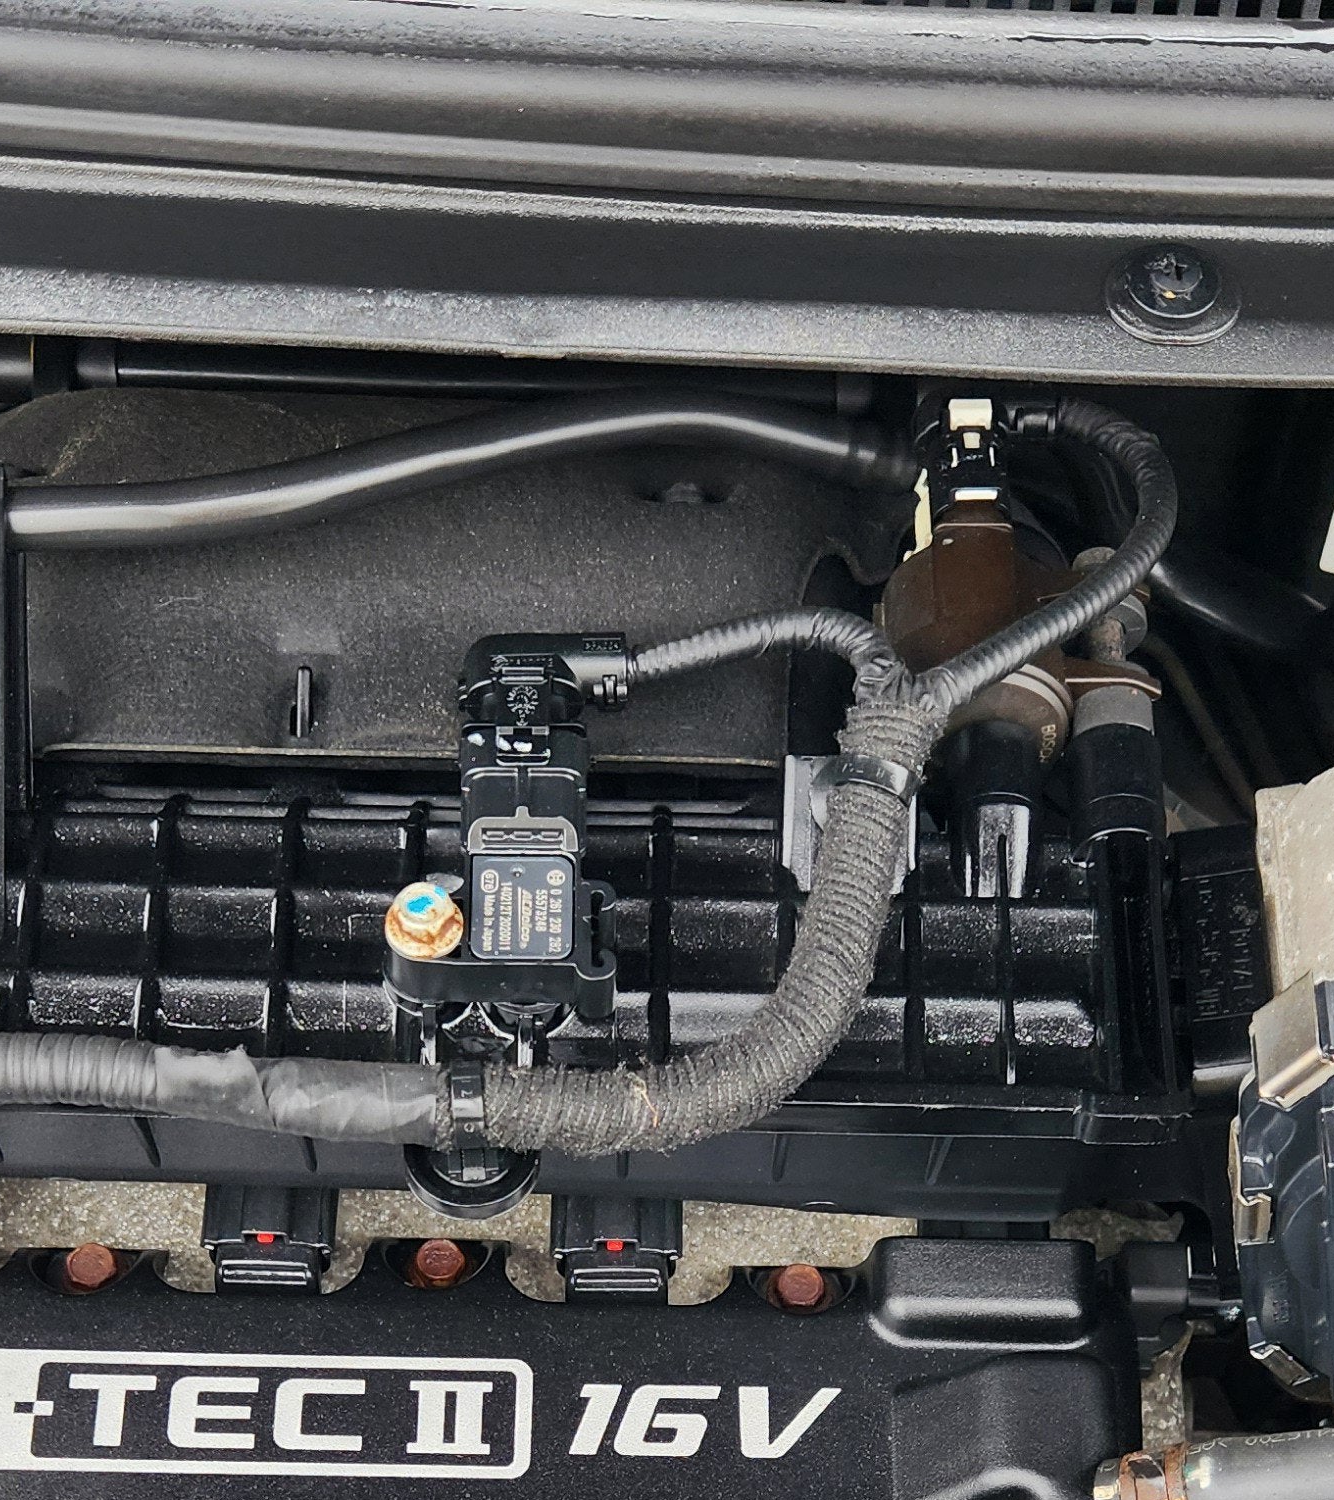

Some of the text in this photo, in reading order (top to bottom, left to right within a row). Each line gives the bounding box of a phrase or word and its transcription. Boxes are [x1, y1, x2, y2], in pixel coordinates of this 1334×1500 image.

[1037, 723, 1059, 765] BOSCH
[483, 894, 496, 916] Made
[480, 926, 495, 952] Japan
[568, 1382, 842, 1460] 16V
